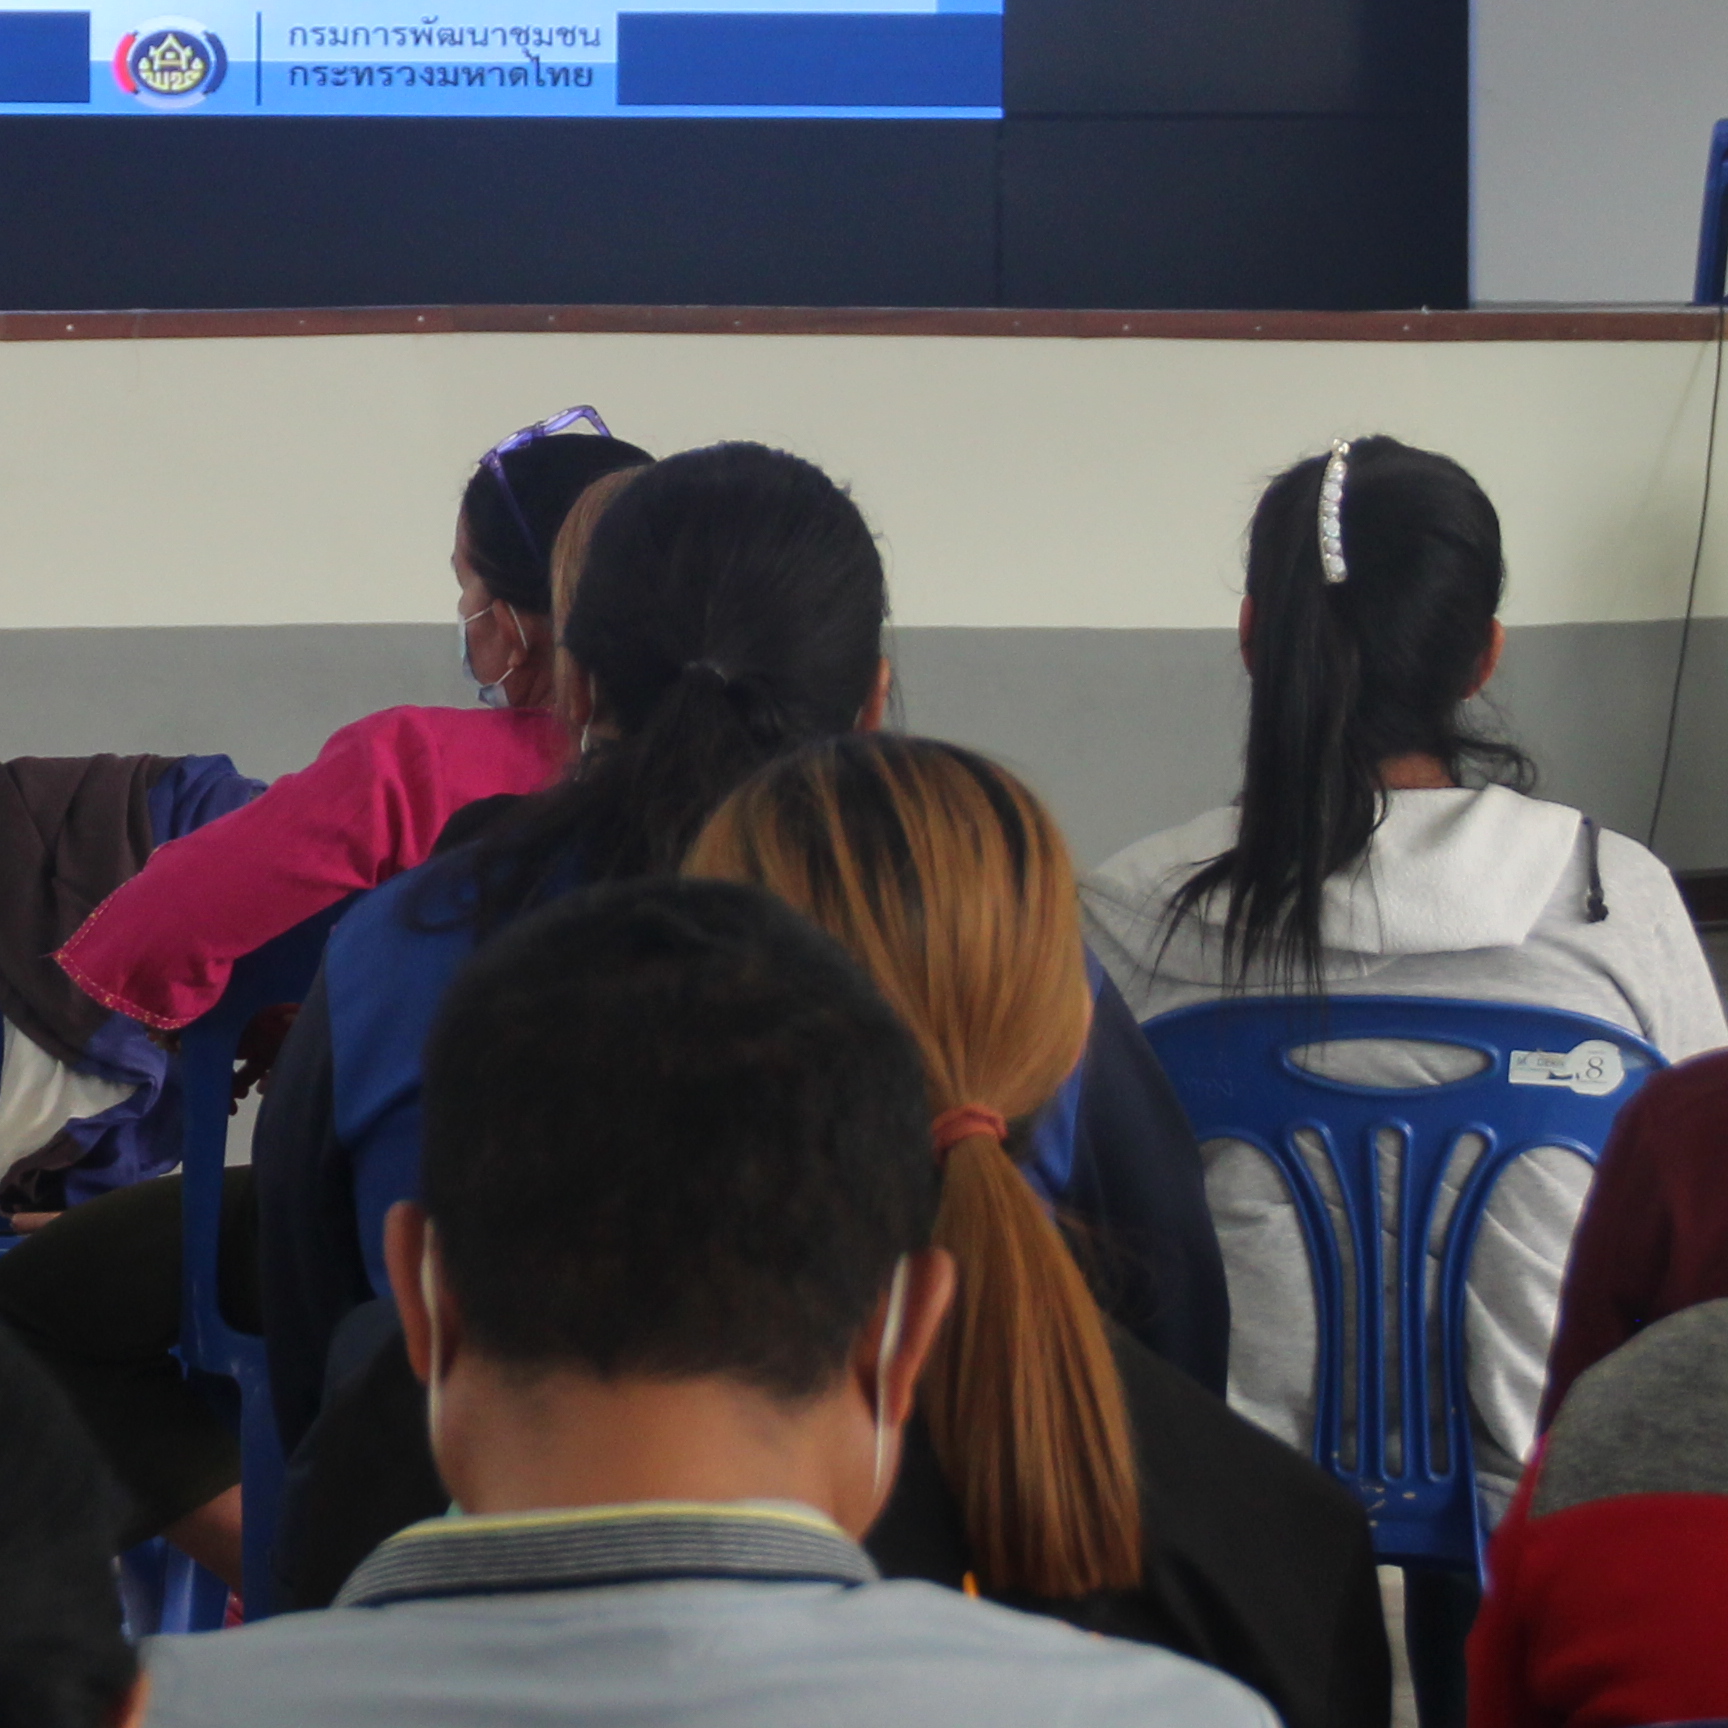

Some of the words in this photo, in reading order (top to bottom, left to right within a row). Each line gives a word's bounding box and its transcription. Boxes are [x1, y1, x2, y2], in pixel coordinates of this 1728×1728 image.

[288, 18, 602, 55] กรมการพัฒนาชุมชน
[288, 54, 595, 89] กระทรวงมหาดไทย
